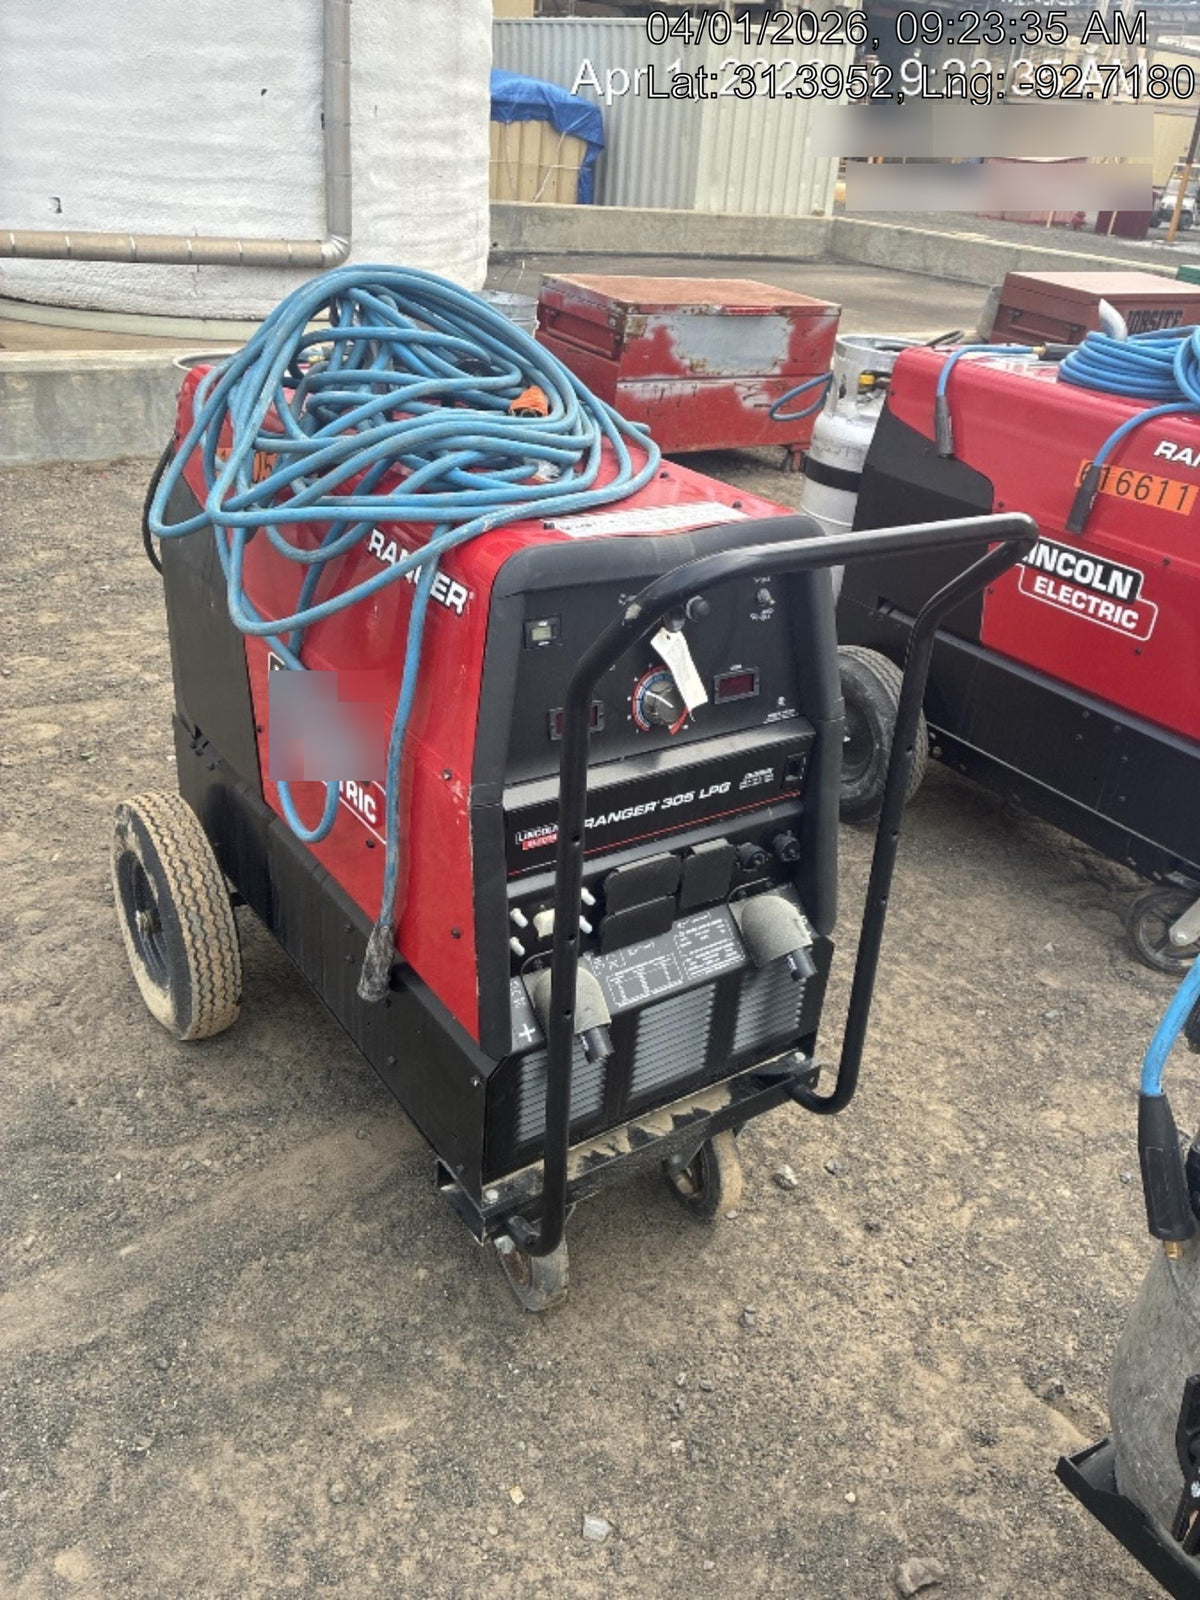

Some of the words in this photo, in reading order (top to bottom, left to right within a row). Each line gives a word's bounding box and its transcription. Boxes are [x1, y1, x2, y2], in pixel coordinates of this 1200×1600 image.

[368, 528, 468, 615] RANER
[1033, 575, 1139, 630] ELECTRIC
[661, 791, 696, 810] 305
[699, 781, 732, 800] LPG
